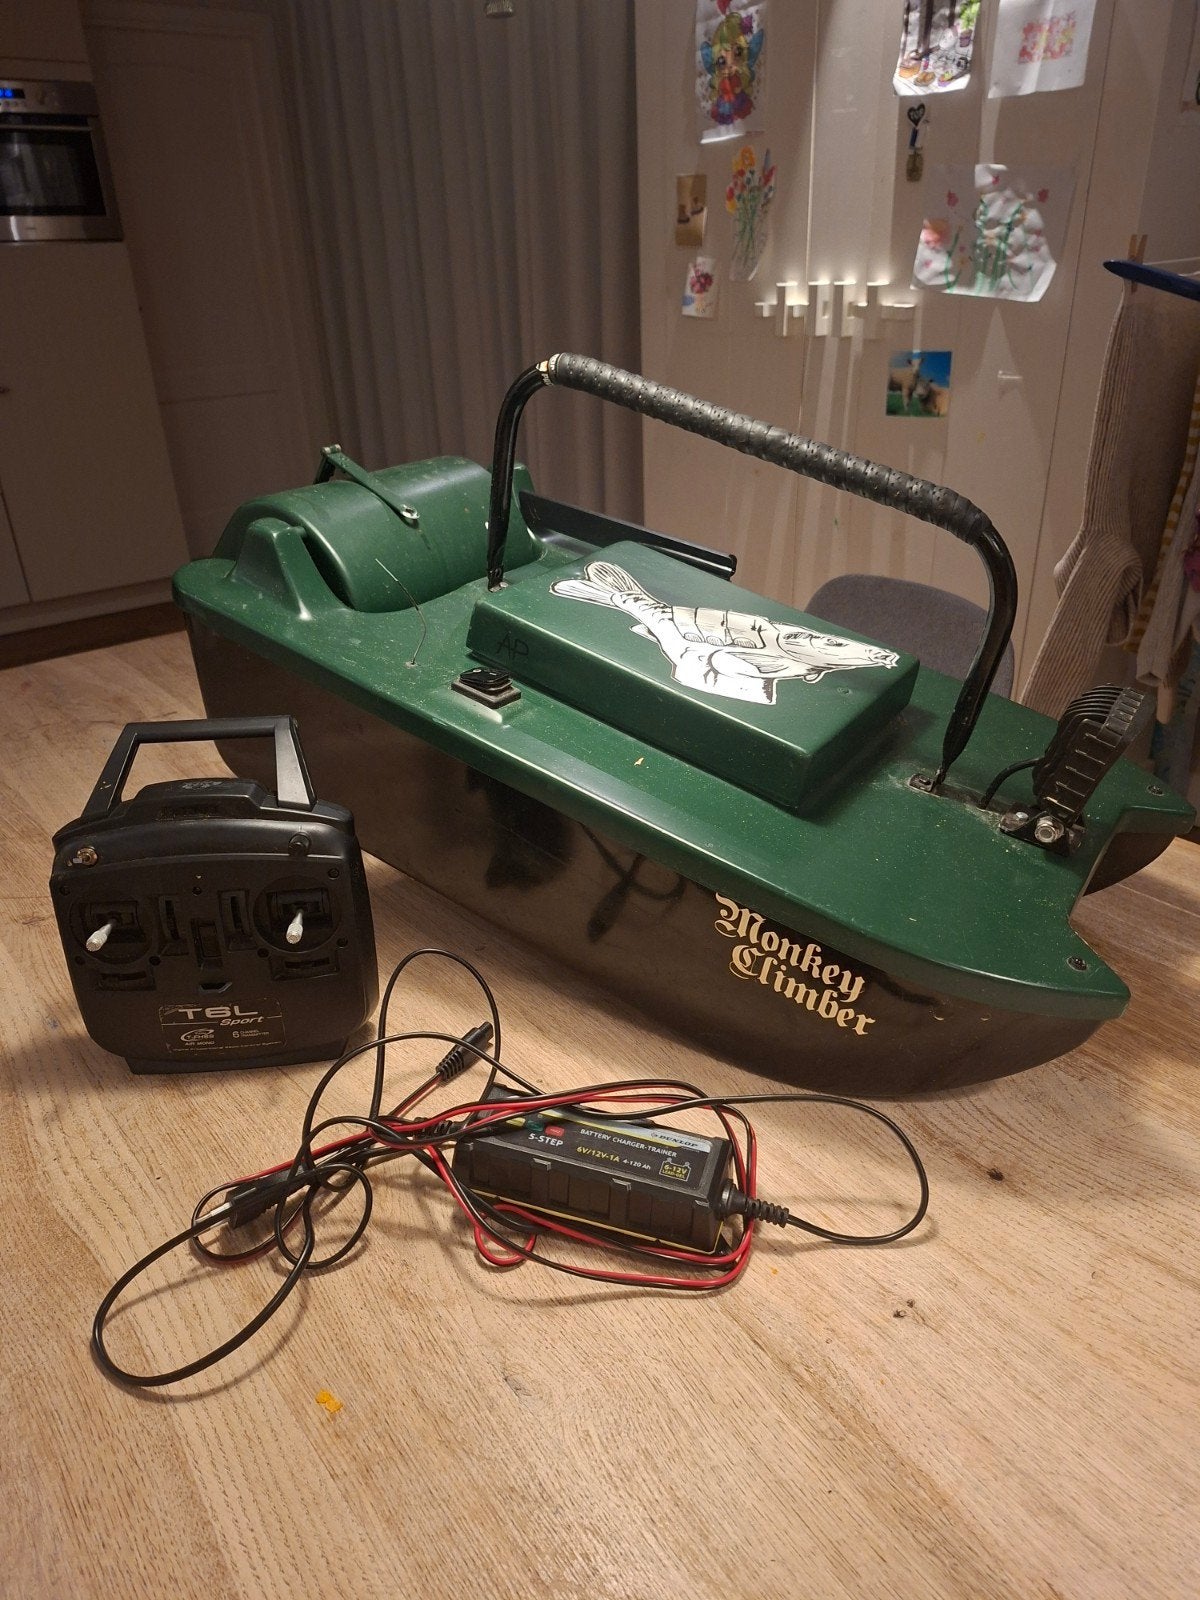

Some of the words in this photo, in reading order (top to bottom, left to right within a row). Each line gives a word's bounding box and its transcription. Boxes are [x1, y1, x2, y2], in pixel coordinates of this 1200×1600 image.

[714, 892, 865, 1003] Monkey
[729, 944, 876, 1036] Climber
[178, 1005, 259, 1020] T6L
[220, 1016, 264, 1026] Sport
[580, 1128, 612, 1141] BATTERY
[612, 1137, 678, 1158] CHARGER-TRAINER
[659, 1134, 699, 1148] DUNLOP
[576, 1146, 621, 1163] 6V/12V-1A
[622, 1158, 642, 1168] 4-120
[664, 1164, 688, 1175] 6-12V
